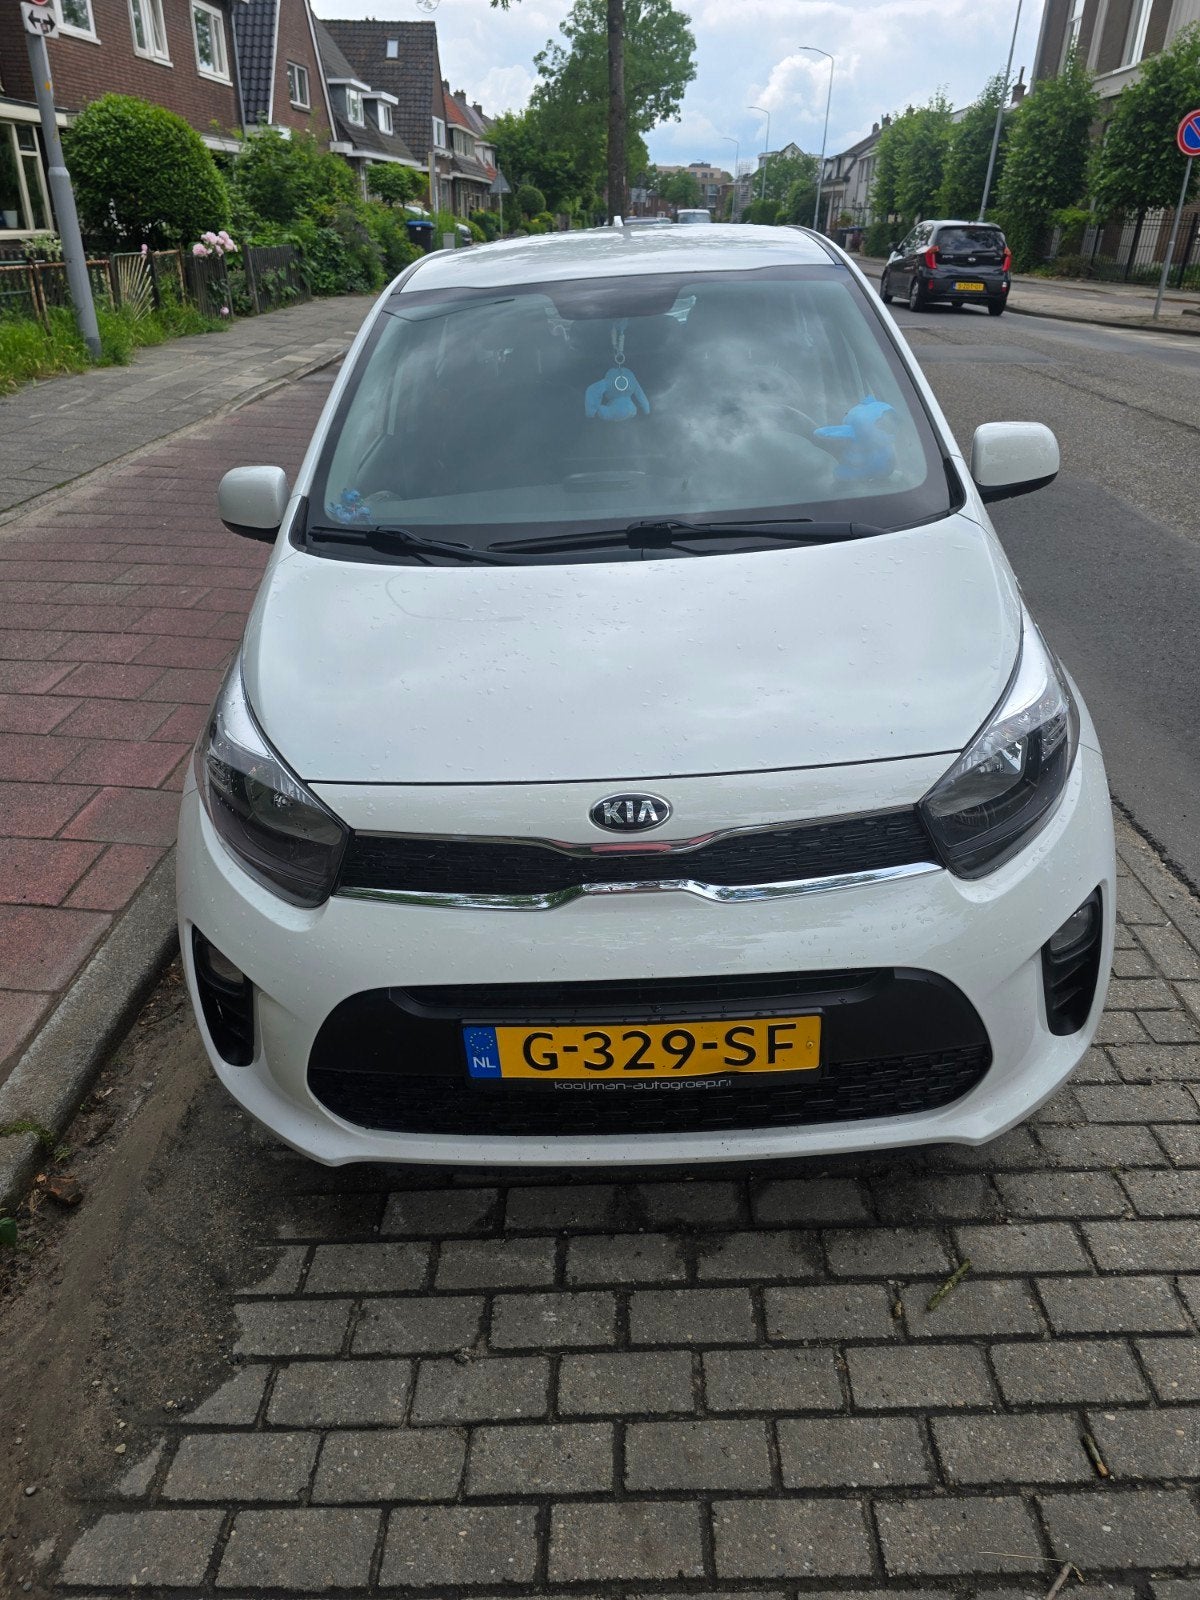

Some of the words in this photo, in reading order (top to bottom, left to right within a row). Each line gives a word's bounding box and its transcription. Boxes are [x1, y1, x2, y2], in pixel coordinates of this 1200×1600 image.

[603, 800, 658, 824] KIA
[472, 1056, 497, 1069] NL
[522, 1023, 797, 1071] G-329-SF
